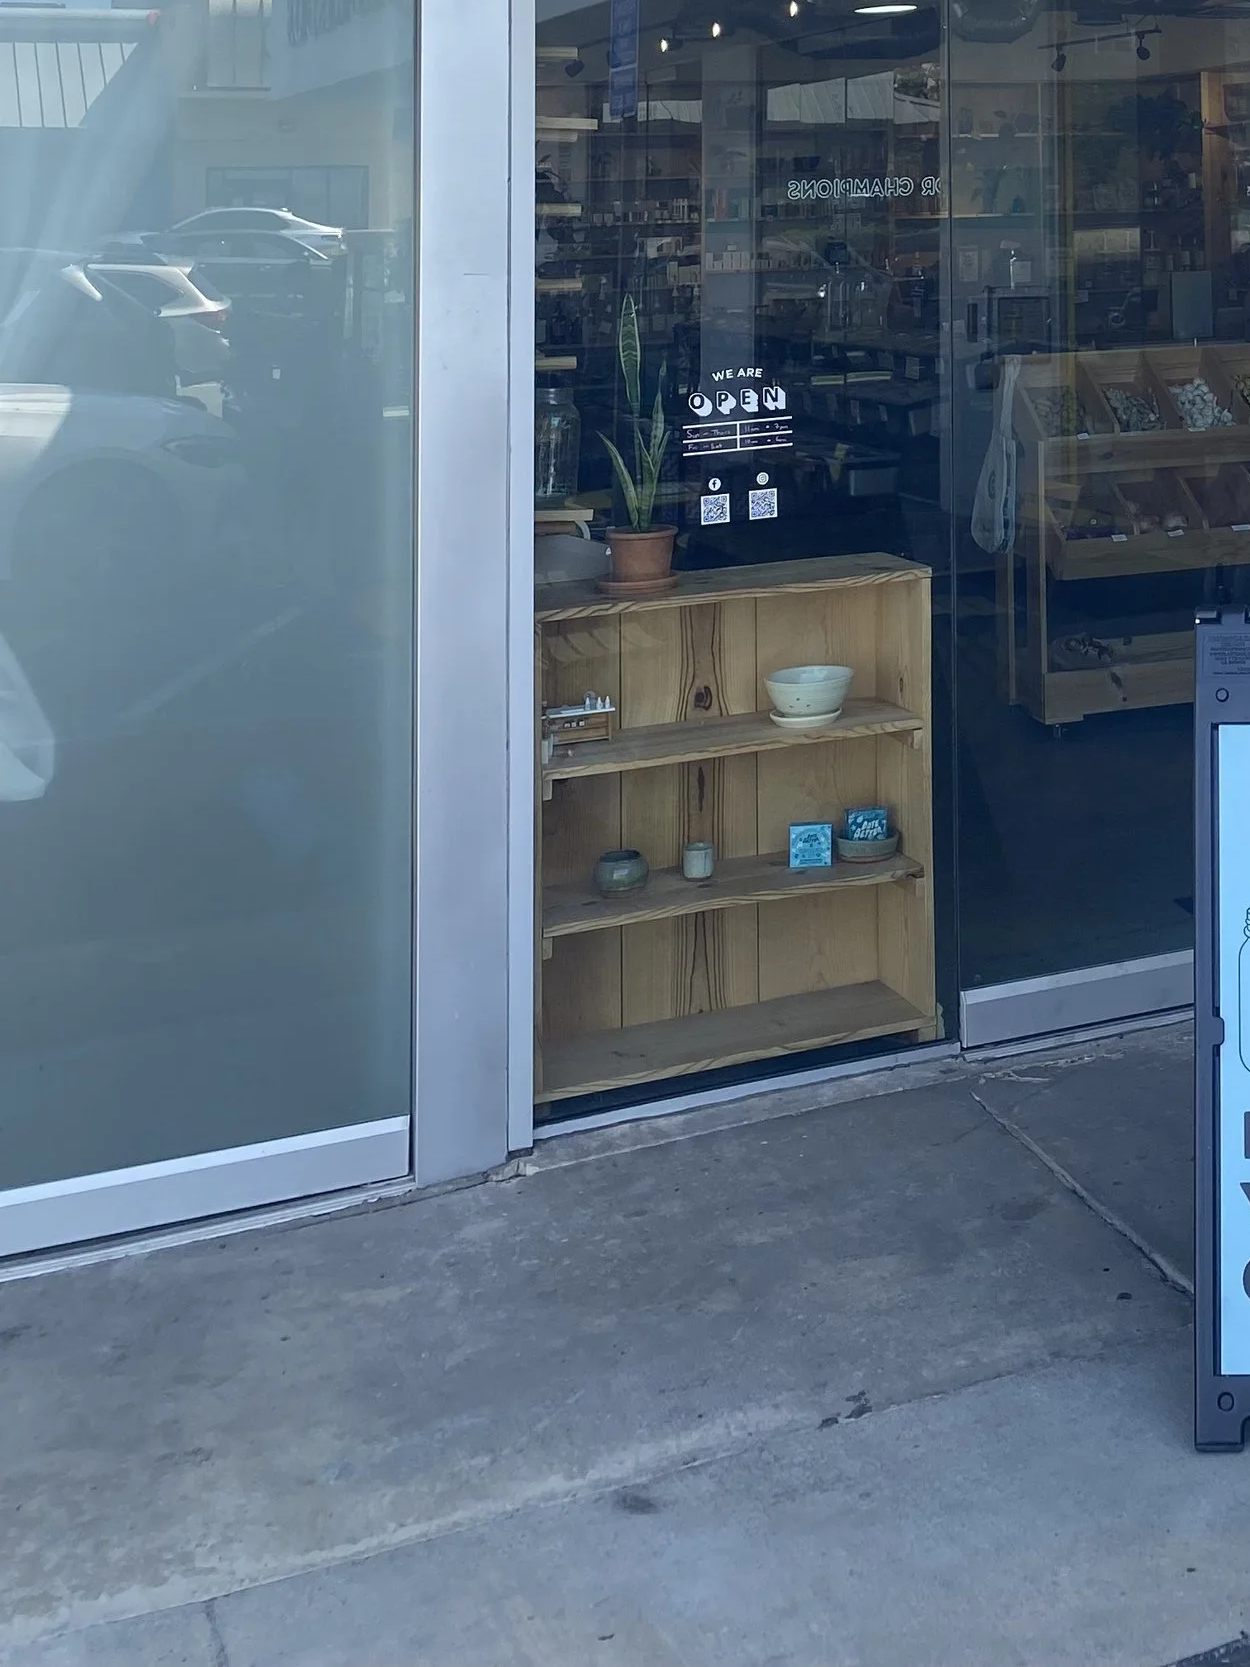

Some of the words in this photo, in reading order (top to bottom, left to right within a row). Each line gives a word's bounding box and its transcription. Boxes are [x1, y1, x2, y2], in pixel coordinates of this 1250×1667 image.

[711, 368, 734, 382] WE
[737, 367, 764, 379] ARE
[688, 385, 787, 418] OPEN
